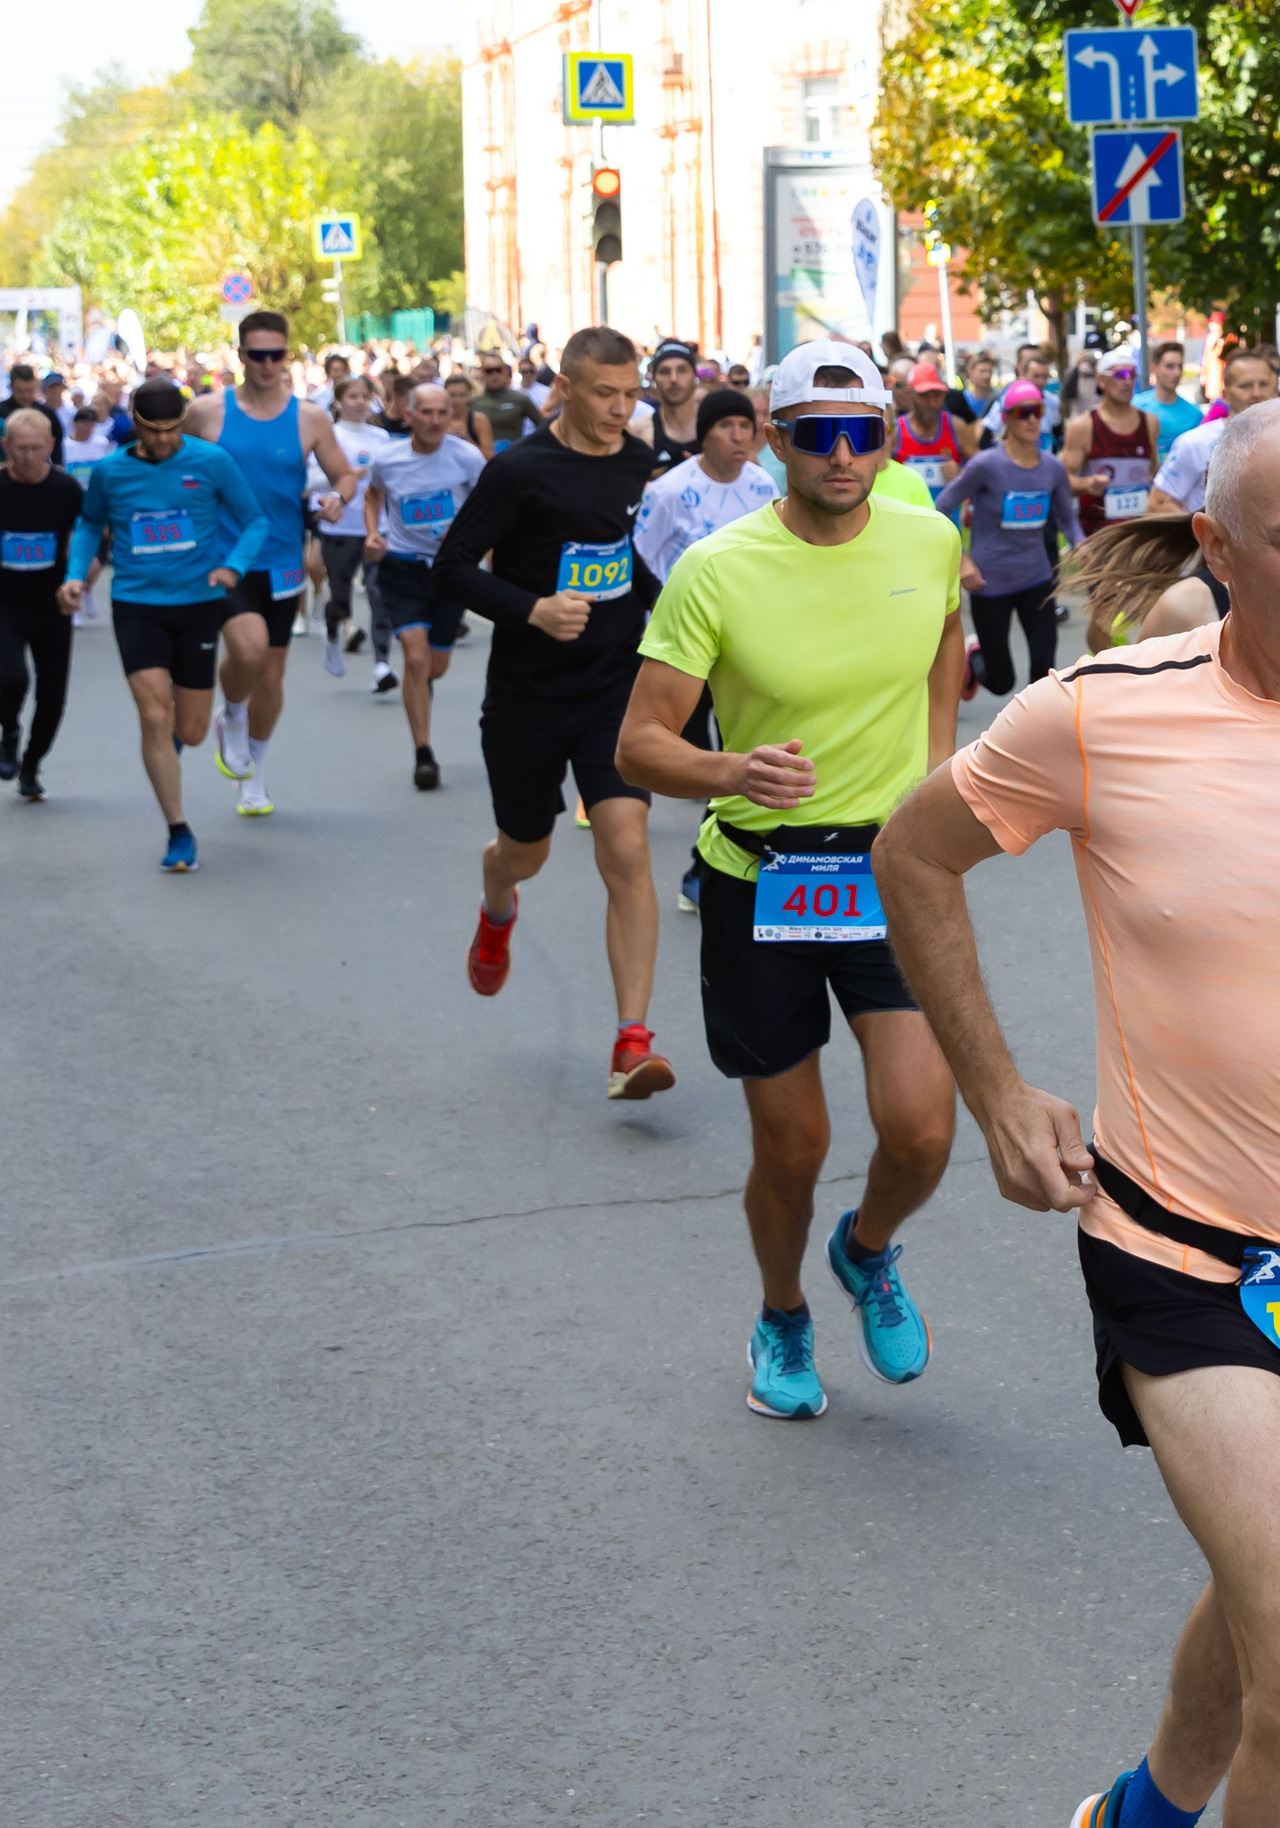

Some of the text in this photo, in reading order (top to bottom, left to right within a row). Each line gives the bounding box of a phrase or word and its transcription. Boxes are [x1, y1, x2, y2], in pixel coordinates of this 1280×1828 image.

[567, 557, 628, 587] 1092
[787, 855, 864, 864] ДИНАМОВСКАЯ
[811, 864, 840, 872] МИЛЯ
[782, 884, 862, 917] 401
